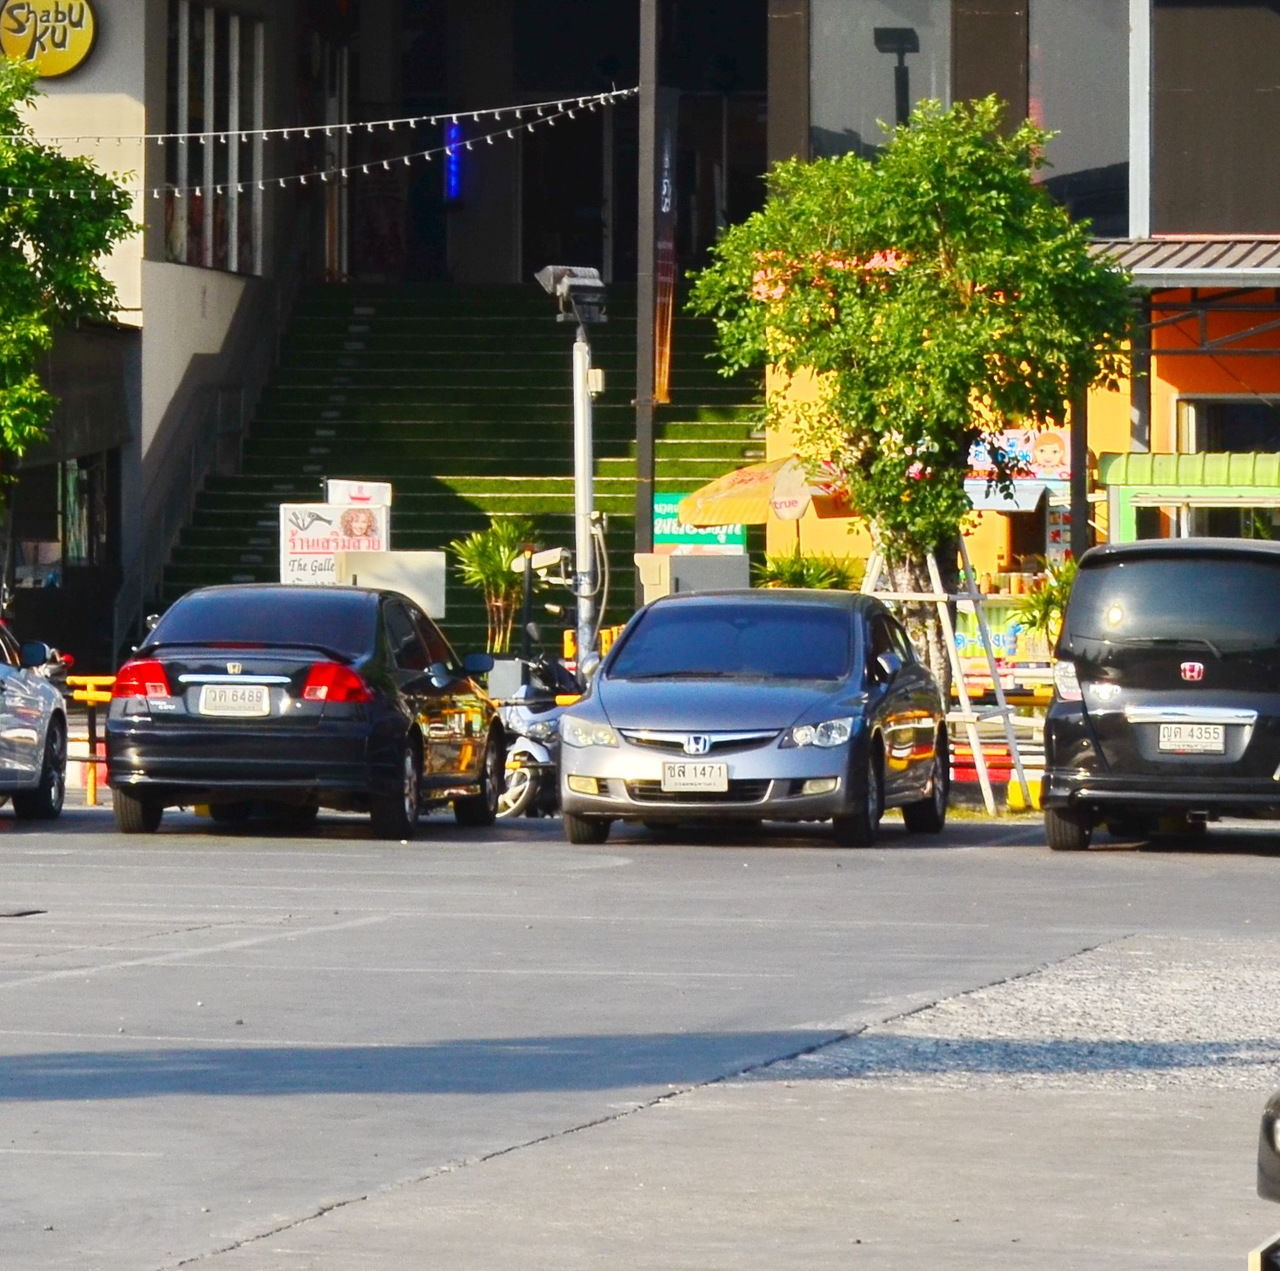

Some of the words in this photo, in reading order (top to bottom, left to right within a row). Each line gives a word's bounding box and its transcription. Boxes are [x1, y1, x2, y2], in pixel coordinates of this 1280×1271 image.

[773, 499, 799, 509] true
[289, 559, 307, 572] The
[1188, 727, 1220, 740] 4355
[693, 765, 723, 778] 1471
